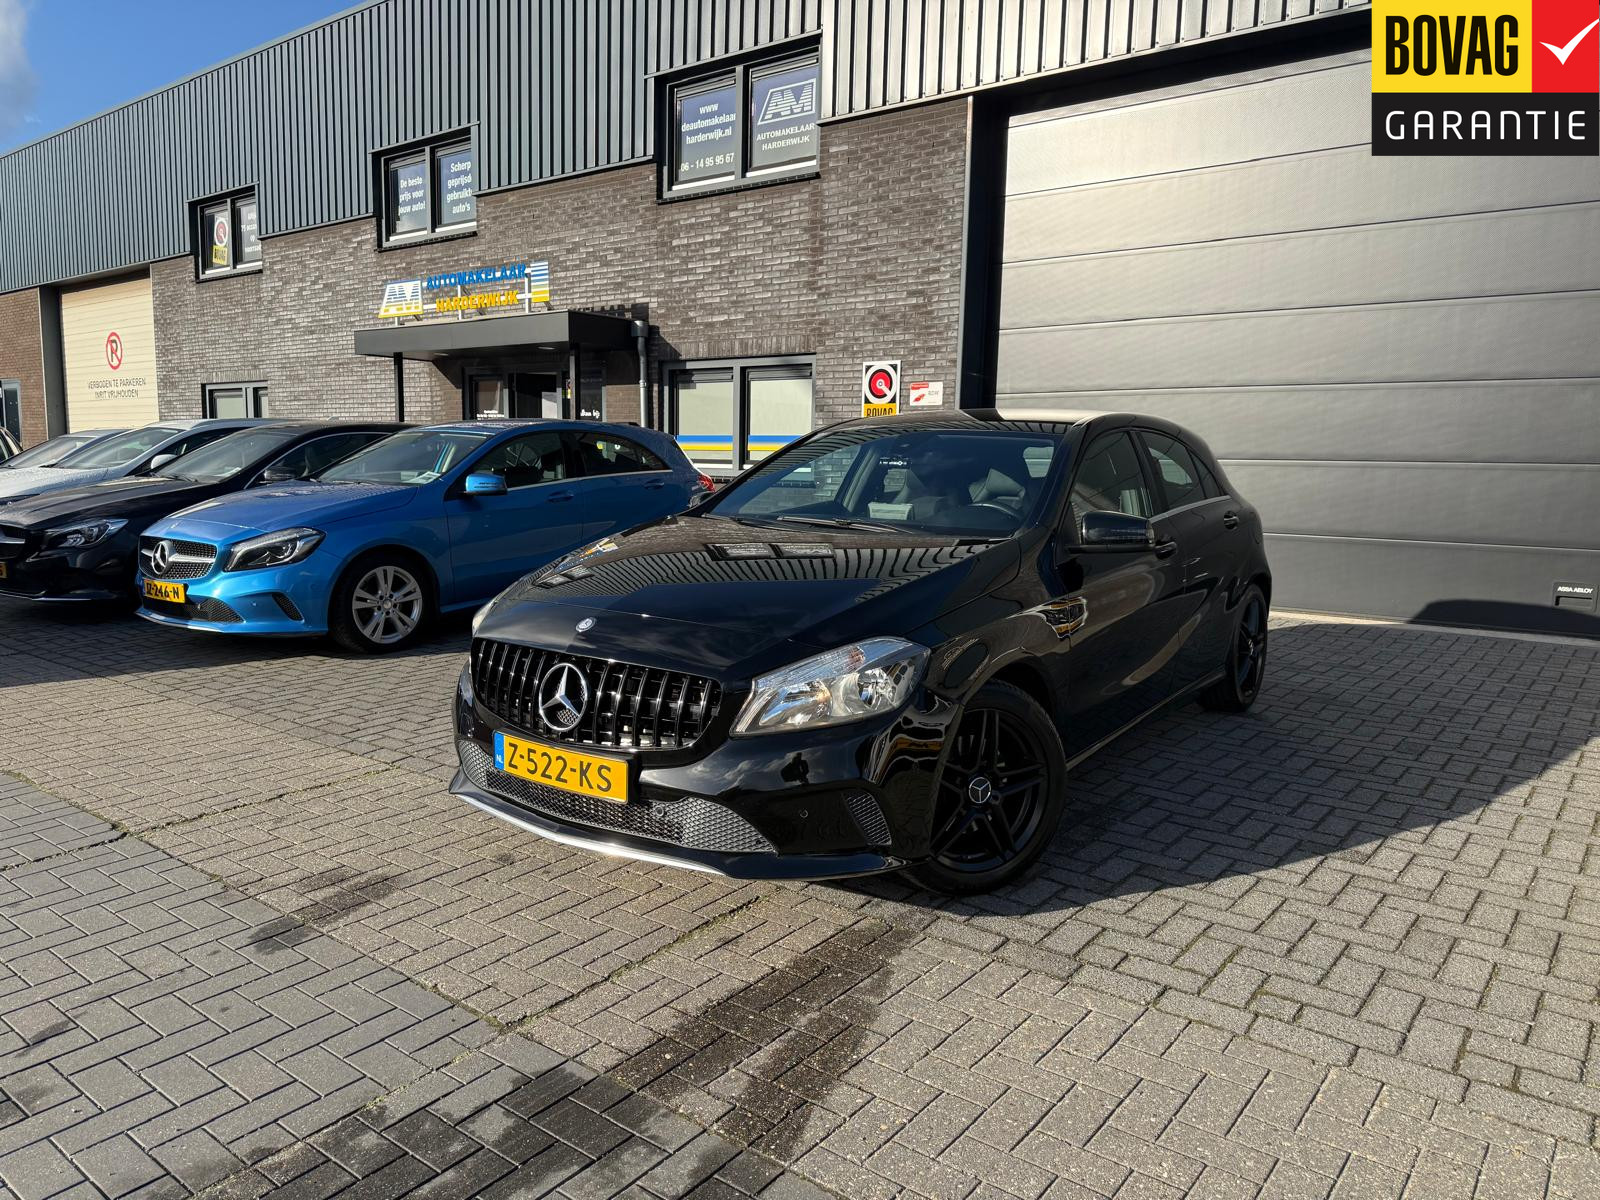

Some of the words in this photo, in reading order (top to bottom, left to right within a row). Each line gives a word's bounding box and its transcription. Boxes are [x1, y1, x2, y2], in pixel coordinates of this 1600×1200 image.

[700, 103, 719, 114] www
[682, 113, 736, 132] deautomakelaar
[686, 126, 732, 144] harderwijk.nl
[756, 122, 816, 141] AUTOMAKELAAR
[762, 135, 810, 151] HARDERWIJK
[450, 161, 472, 172] Scherp
[680, 162, 690, 172] 06
[696, 158, 704, 168] 14
[705, 156, 714, 167] 95
[715, 154, 724, 165] 95
[726, 152, 734, 163] 67
[400, 180, 408, 188] De
[408, 176, 422, 186] beste
[448, 174, 472, 188] geprijsd
[400, 191, 412, 203] prijs
[412, 190, 424, 199] voor
[452, 202, 471, 214] auto's
[426, 264, 527, 290] AUTOMAKELAAR
[436, 290, 519, 313] HARDERWIJK
[88, 380, 112, 389] VERBODEN
[120, 377, 146, 387] PARKEREN
[508, 742, 612, 792] Z-522-KS
